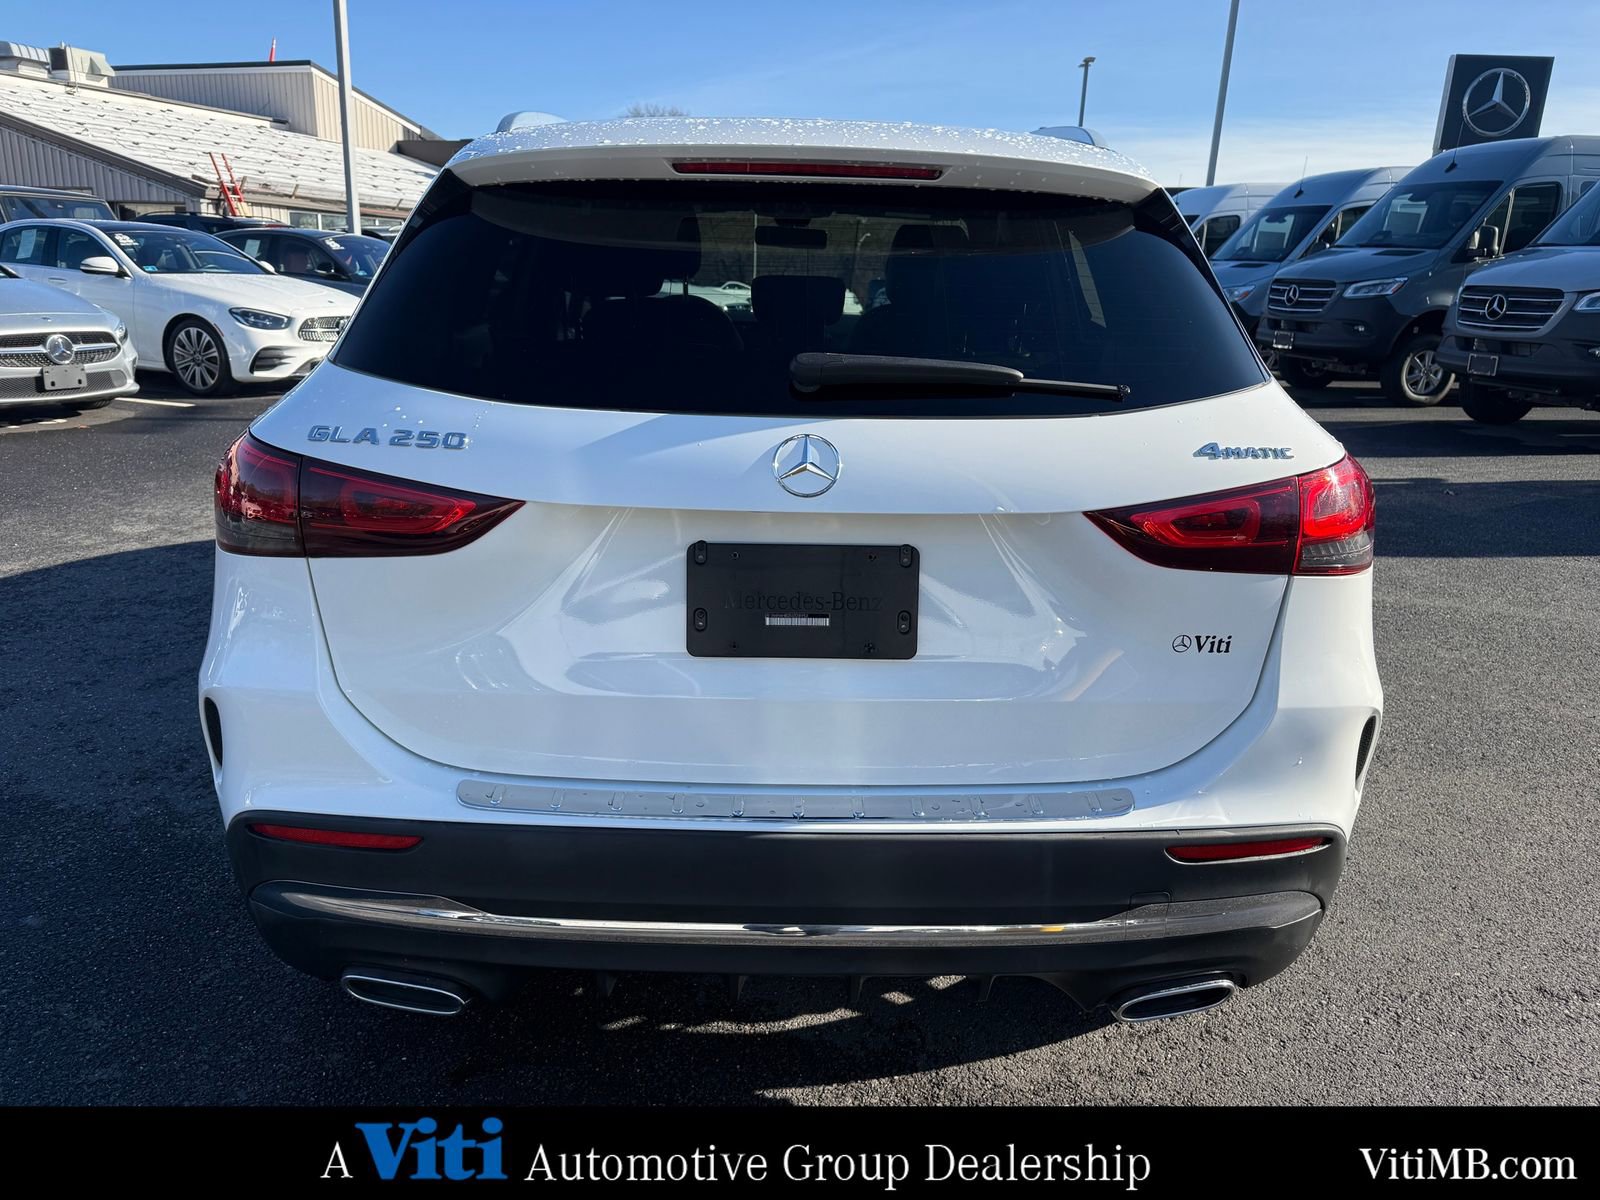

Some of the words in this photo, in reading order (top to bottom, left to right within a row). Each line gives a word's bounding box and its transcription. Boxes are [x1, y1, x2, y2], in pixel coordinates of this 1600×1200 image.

[306, 424, 380, 446] GLA
[388, 429, 469, 450] 250
[1192, 442, 1295, 461] 4MATIC
[722, 590, 883, 612] Mercedes-Benz
[1194, 634, 1233, 654] Viti
